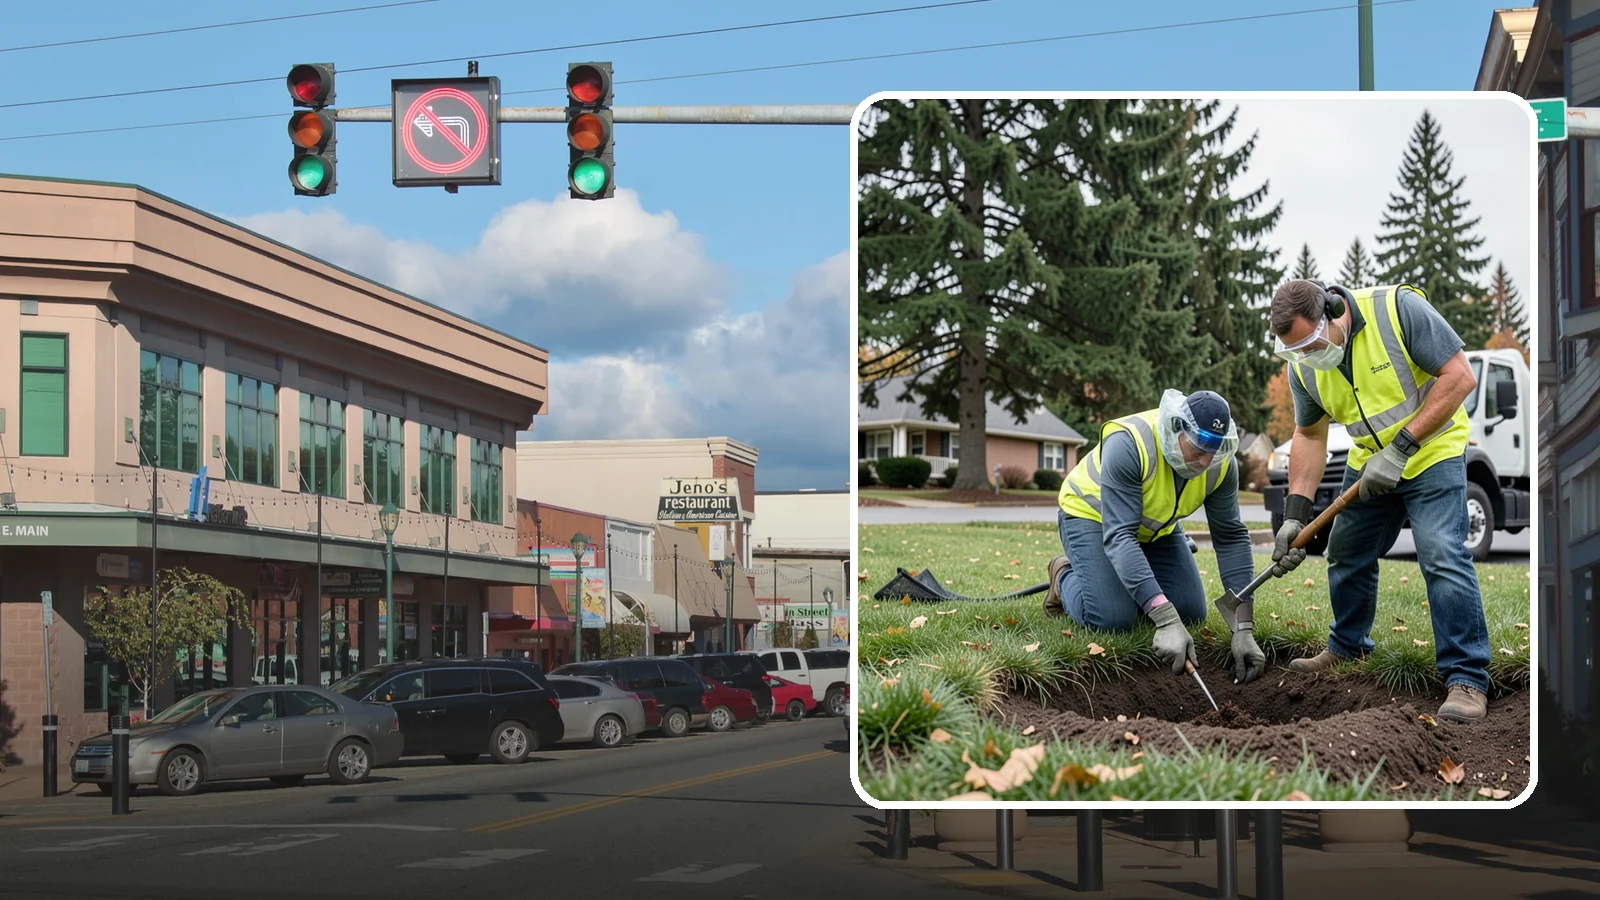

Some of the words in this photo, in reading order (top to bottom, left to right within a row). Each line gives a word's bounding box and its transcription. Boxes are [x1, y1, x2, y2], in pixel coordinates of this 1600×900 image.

[669, 480, 727, 494] Jeno's
[665, 496, 731, 509] restaurant
[658, 509, 681, 519] Italian
[686, 509, 715, 519] American
[715, 509, 738, 519] Cuisine
[2, 525, 13, 536] E.
[15, 525, 49, 536] MAIN
[797, 608, 828, 616] Street
